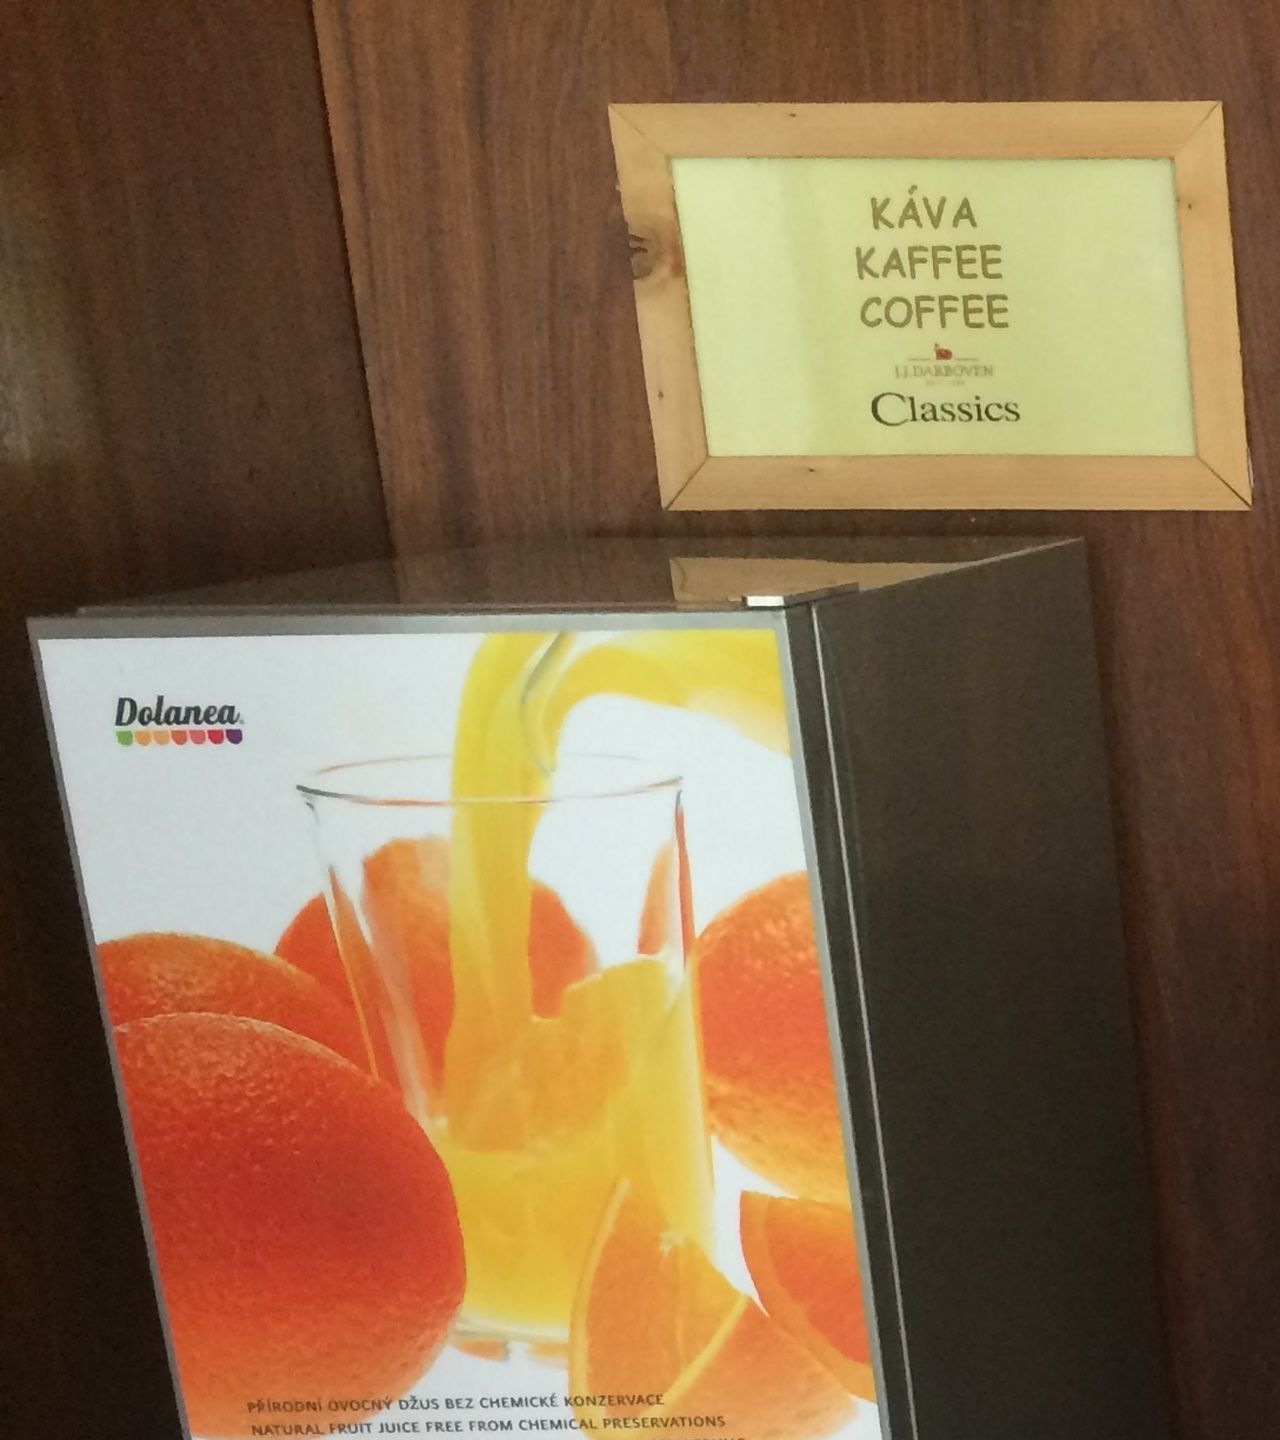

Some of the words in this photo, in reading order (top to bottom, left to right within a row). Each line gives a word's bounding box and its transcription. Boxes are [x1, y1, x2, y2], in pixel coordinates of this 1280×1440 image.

[870, 185, 978, 230] KÁVA
[855, 244, 1003, 280] KAFFEE
[860, 294, 1009, 329] COFFEE
[871, 391, 1021, 427] Classics
[115, 695, 240, 726] Dolanea
[247, 1398, 322, 1413] PŘÍRODNÍ
[328, 1396, 392, 1412] OVOCNÝ
[399, 1395, 440, 1410] DŽUS
[445, 1397, 474, 1410] BEZ
[480, 1393, 557, 1409] CHEMICKÉ
[564, 1394, 665, 1407] KONZERVACE
[252, 1423, 324, 1436] NATURAL
[329, 1422, 373, 1435] FRUIT
[378, 1421, 420, 1434] JUICE
[426, 1421, 463, 1433] FREE
[469, 1419, 513, 1432] FROM
[519, 1418, 598, 1431] CHEMICAL
[602, 1416, 726, 1429] PRESERVATIONS
